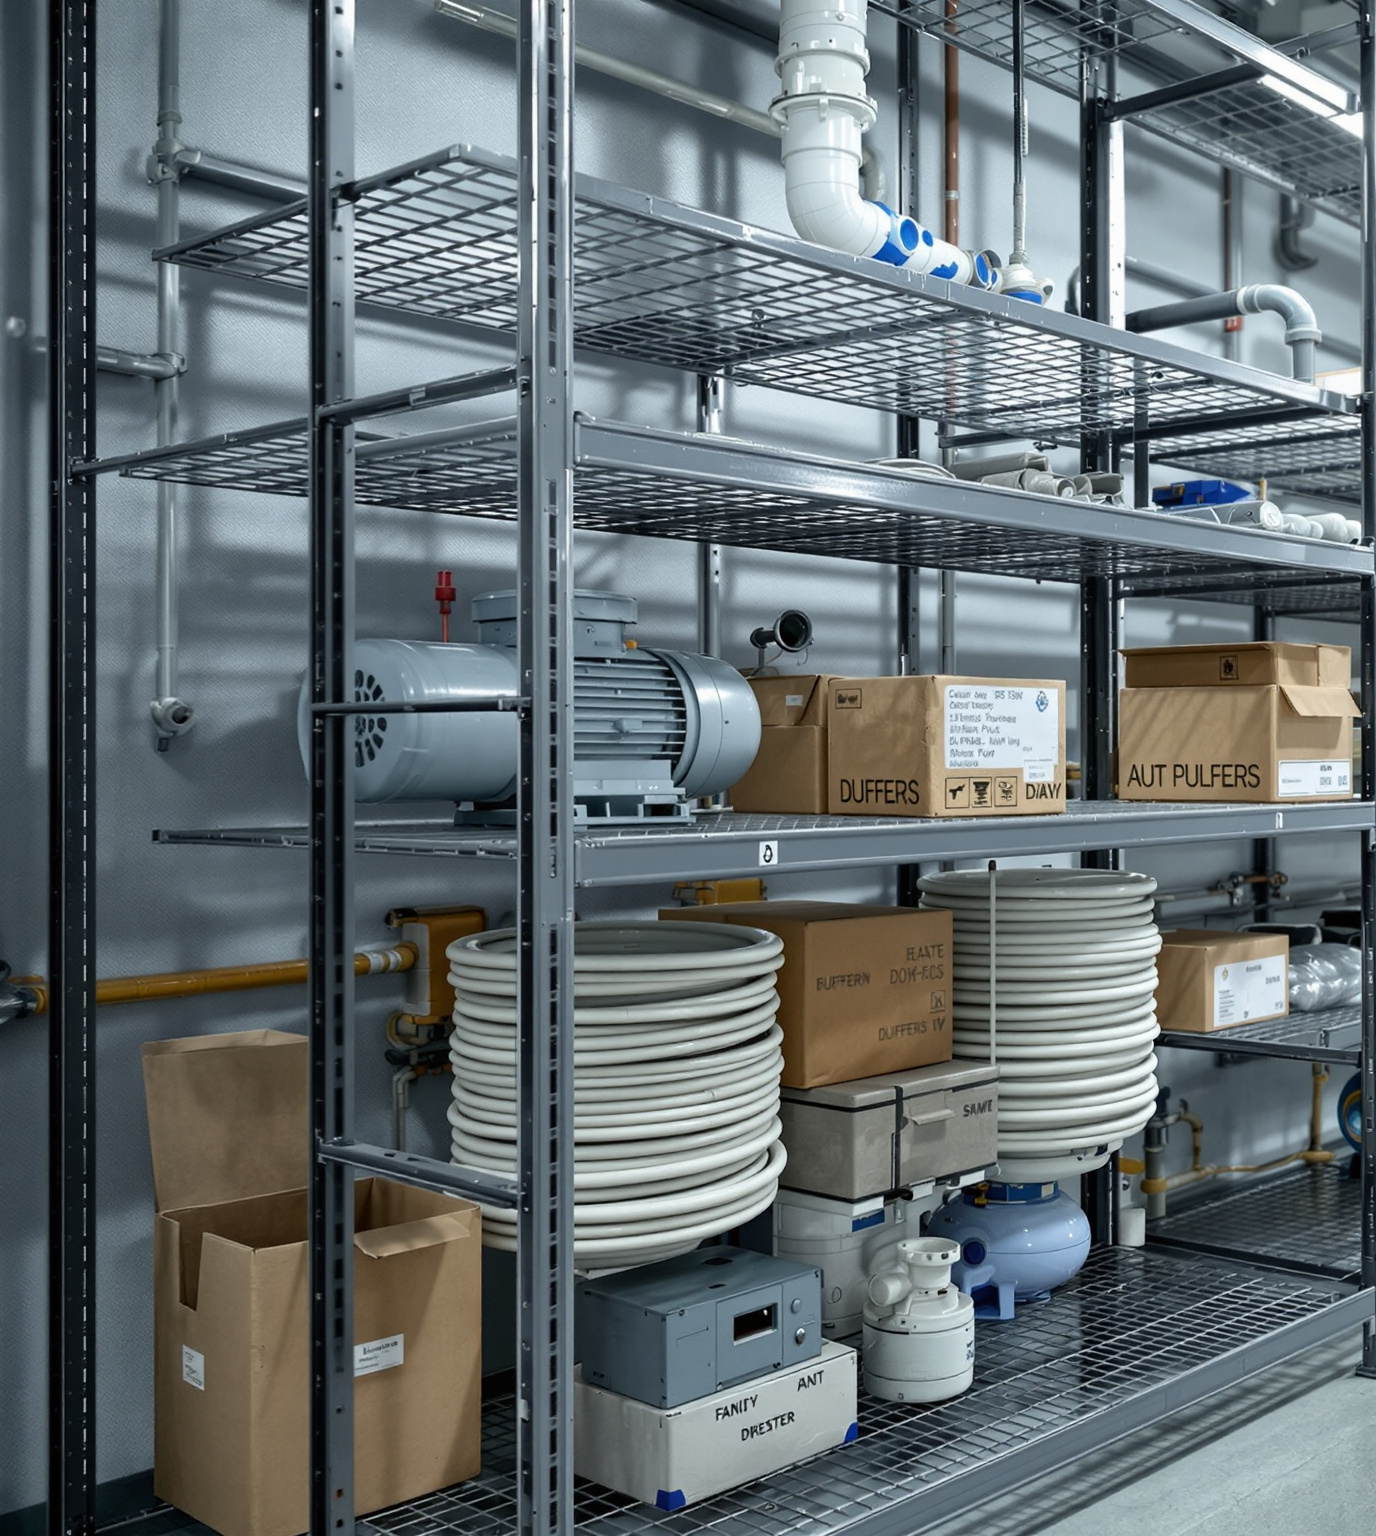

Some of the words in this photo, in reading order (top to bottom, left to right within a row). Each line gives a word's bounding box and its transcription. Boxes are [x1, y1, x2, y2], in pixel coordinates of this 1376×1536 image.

[1127, 764, 1167, 788] AUT
[1173, 764, 1261, 788] PULFERS
[840, 778, 920, 805] DUFFERS
[797, 1369, 825, 1392] ANT
